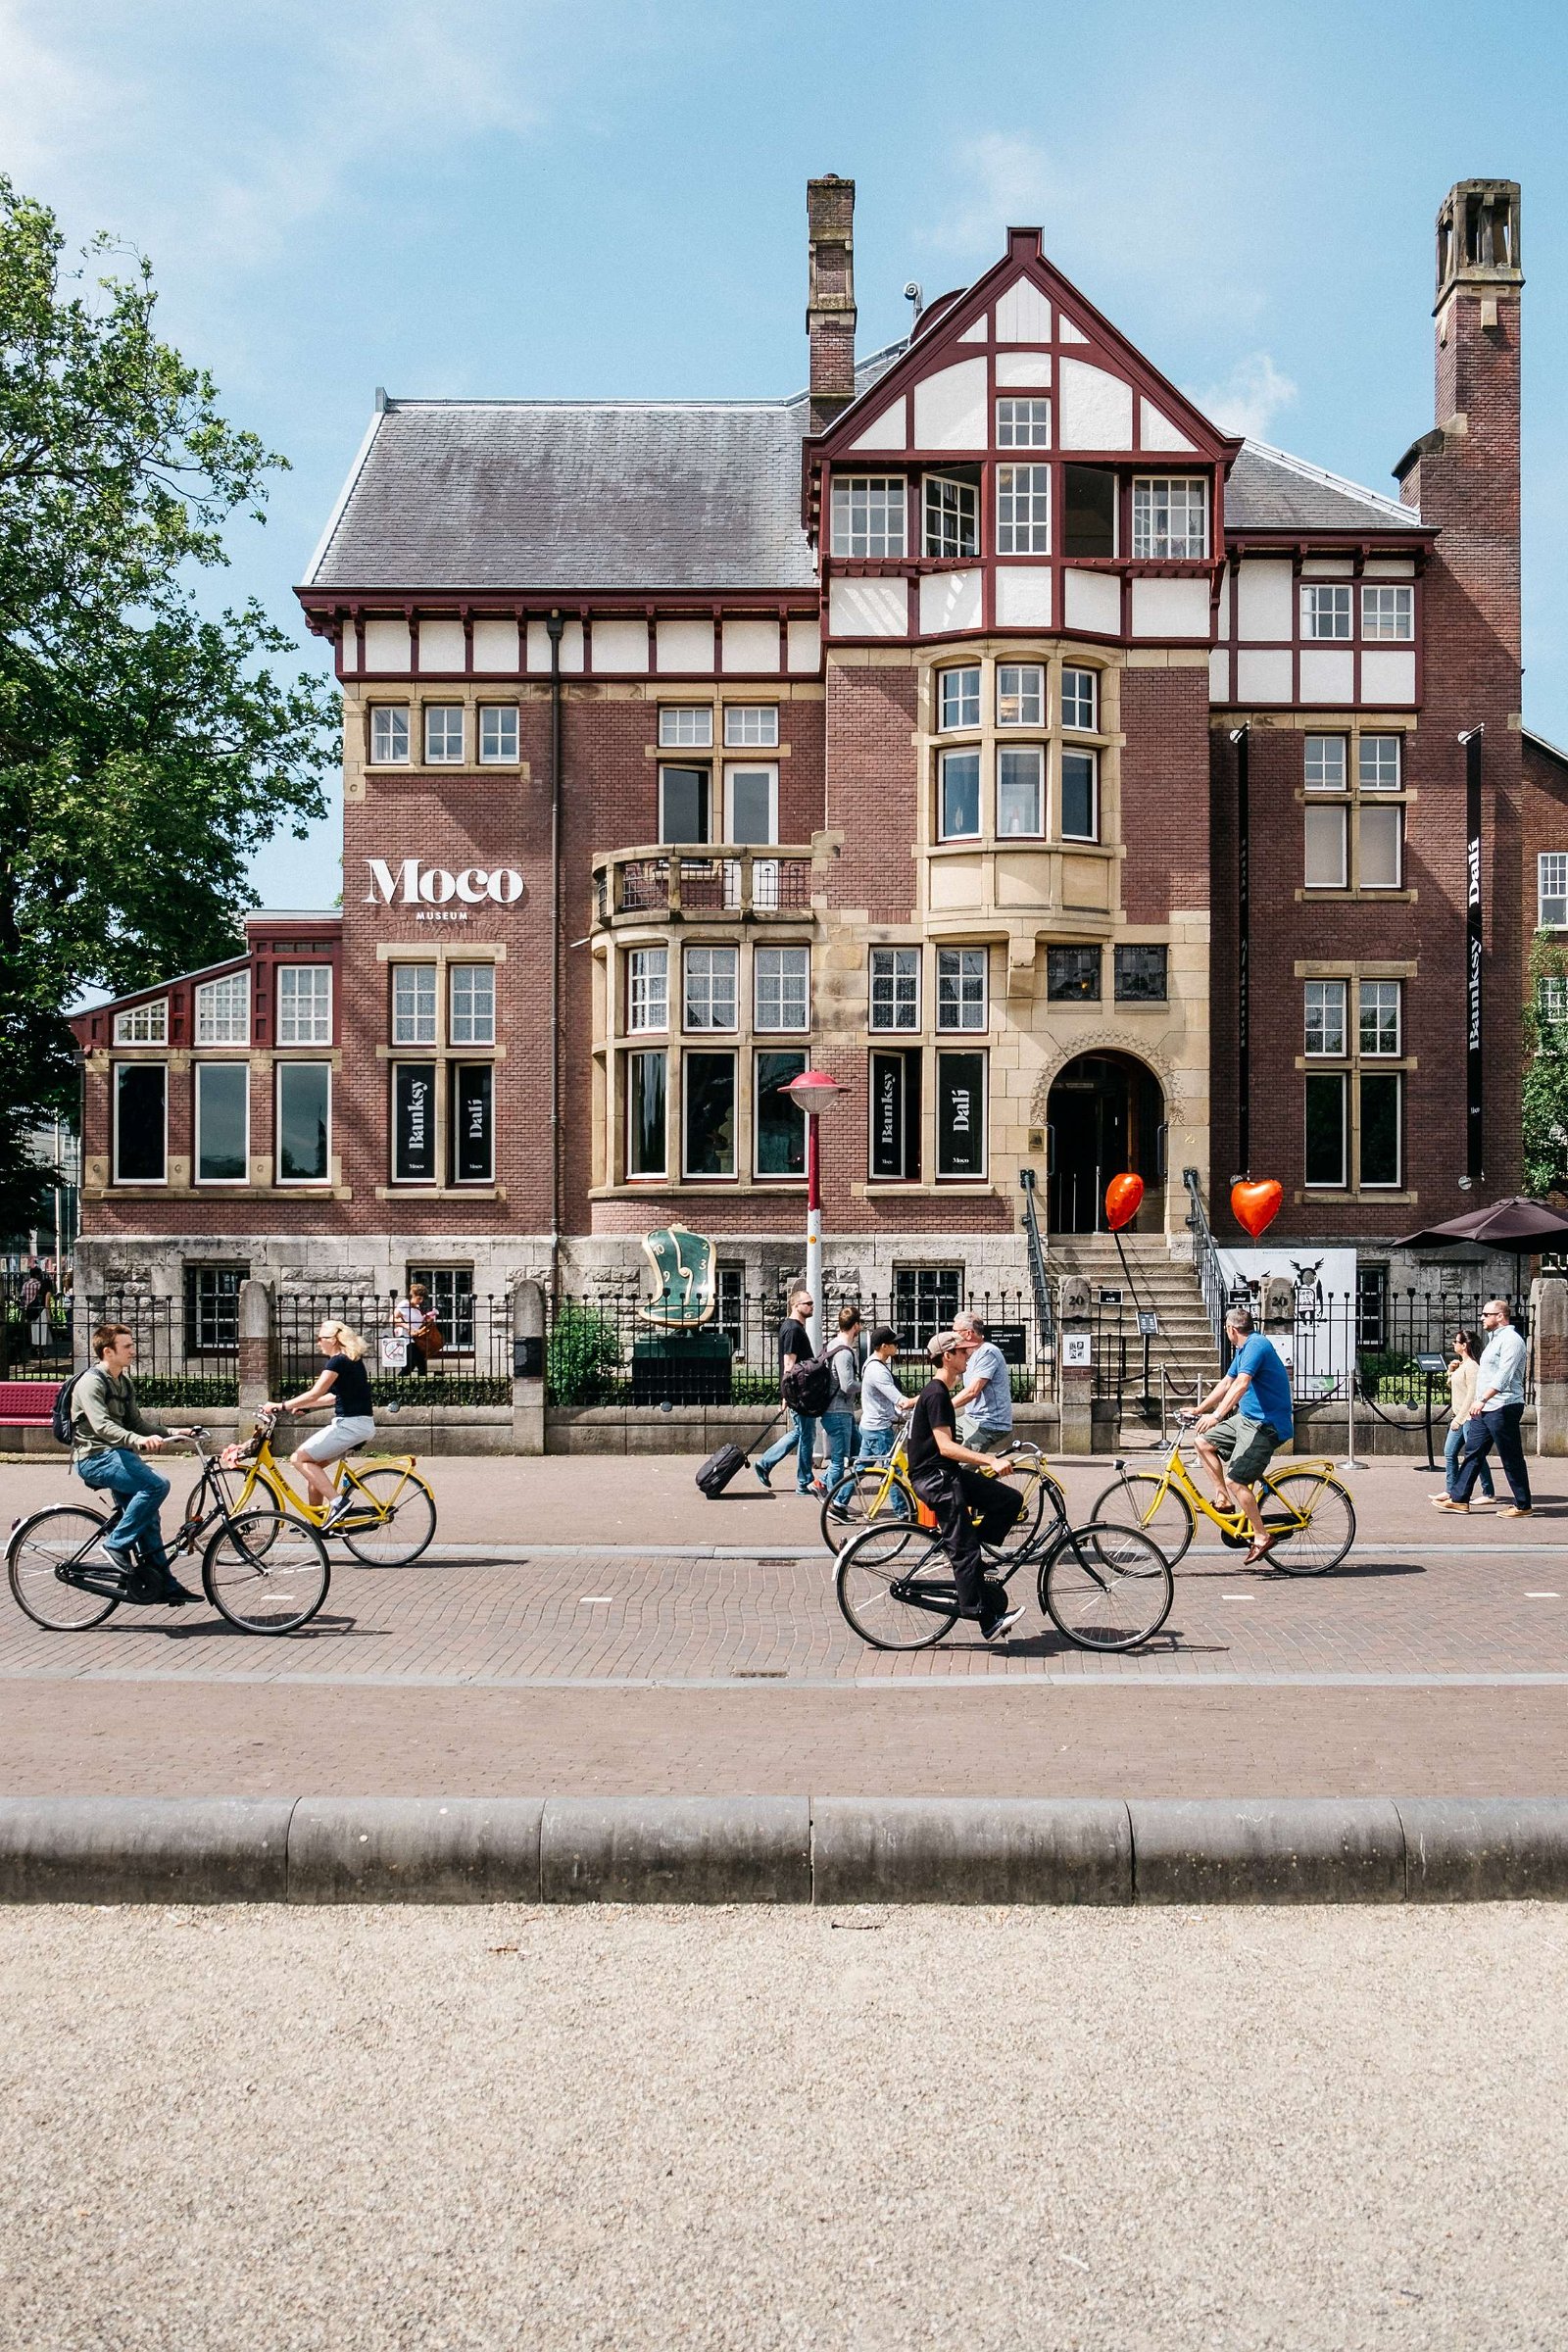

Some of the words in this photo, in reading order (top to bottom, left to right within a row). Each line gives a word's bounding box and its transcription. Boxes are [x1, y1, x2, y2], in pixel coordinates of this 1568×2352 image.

[361, 858, 524, 905] Moco
[1468, 837, 1480, 907] Dalí
[416, 911, 467, 920] MUSEUM
[1468, 936, 1482, 1051] Banksy
[408, 1079, 428, 1150] Banksy
[467, 1099, 483, 1139] Dalí
[881, 1070, 896, 1145] Banksy
[951, 1089, 969, 1132] Dalí
[653, 1244, 665, 1256] 10
[699, 1258, 707, 1270] 3
[662, 1270, 671, 1283] 9
[1069, 1296, 1085, 1305] 20
[1271, 1296, 1288, 1306] 20
